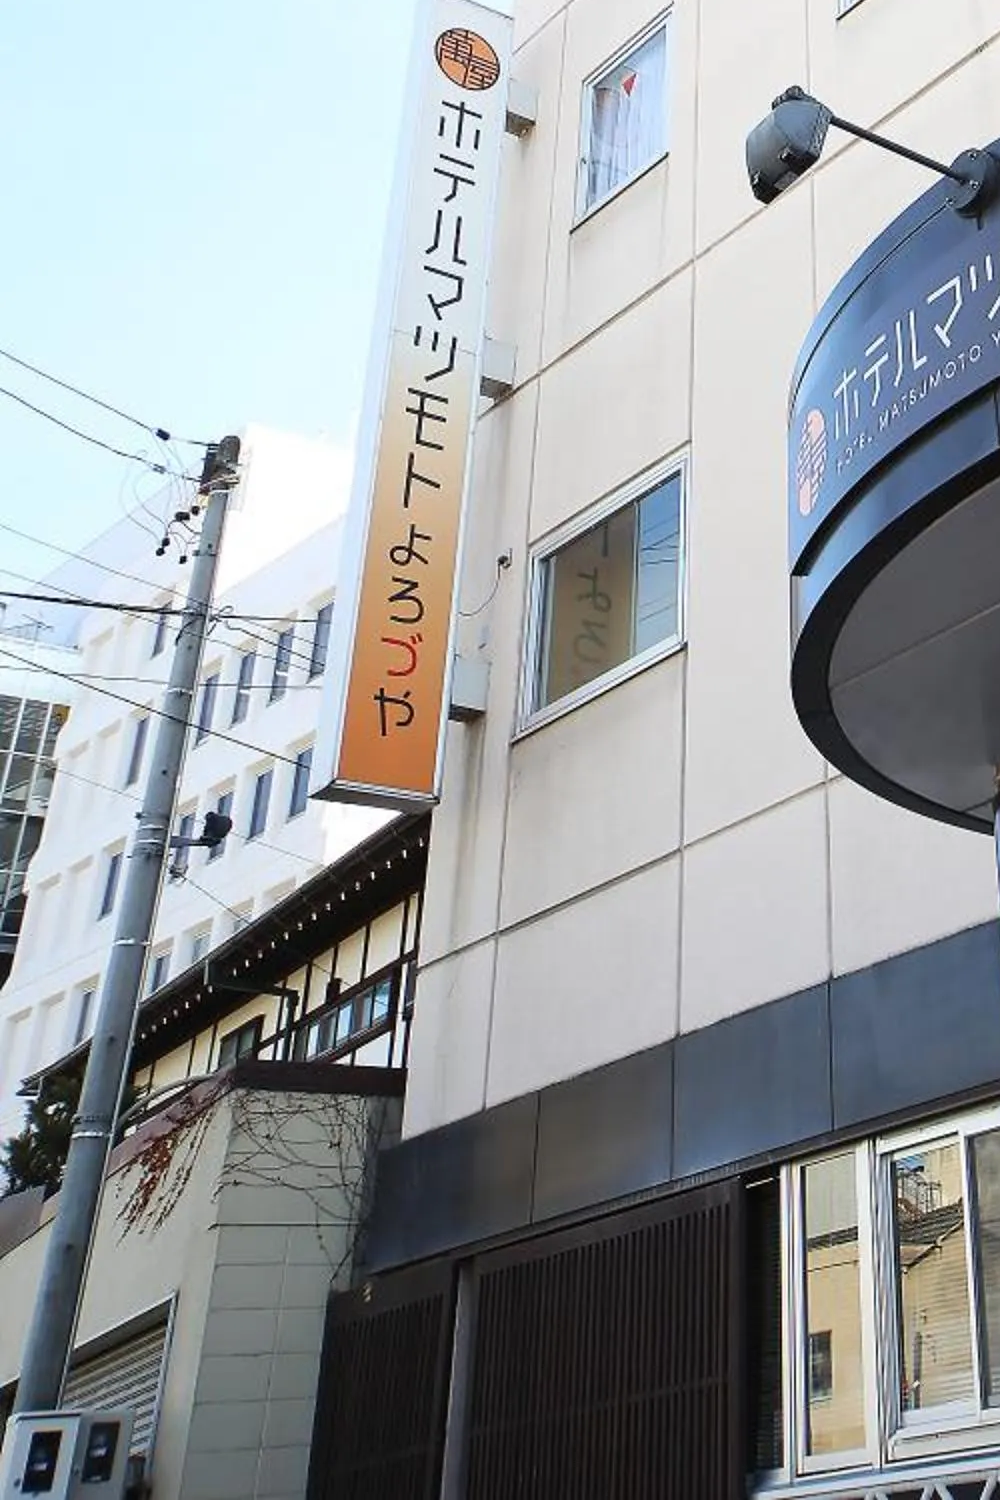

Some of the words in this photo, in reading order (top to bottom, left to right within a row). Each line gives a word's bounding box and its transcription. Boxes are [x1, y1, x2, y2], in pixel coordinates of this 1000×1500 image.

[374, 100, 482, 737] ホテルマツモトよろづや
